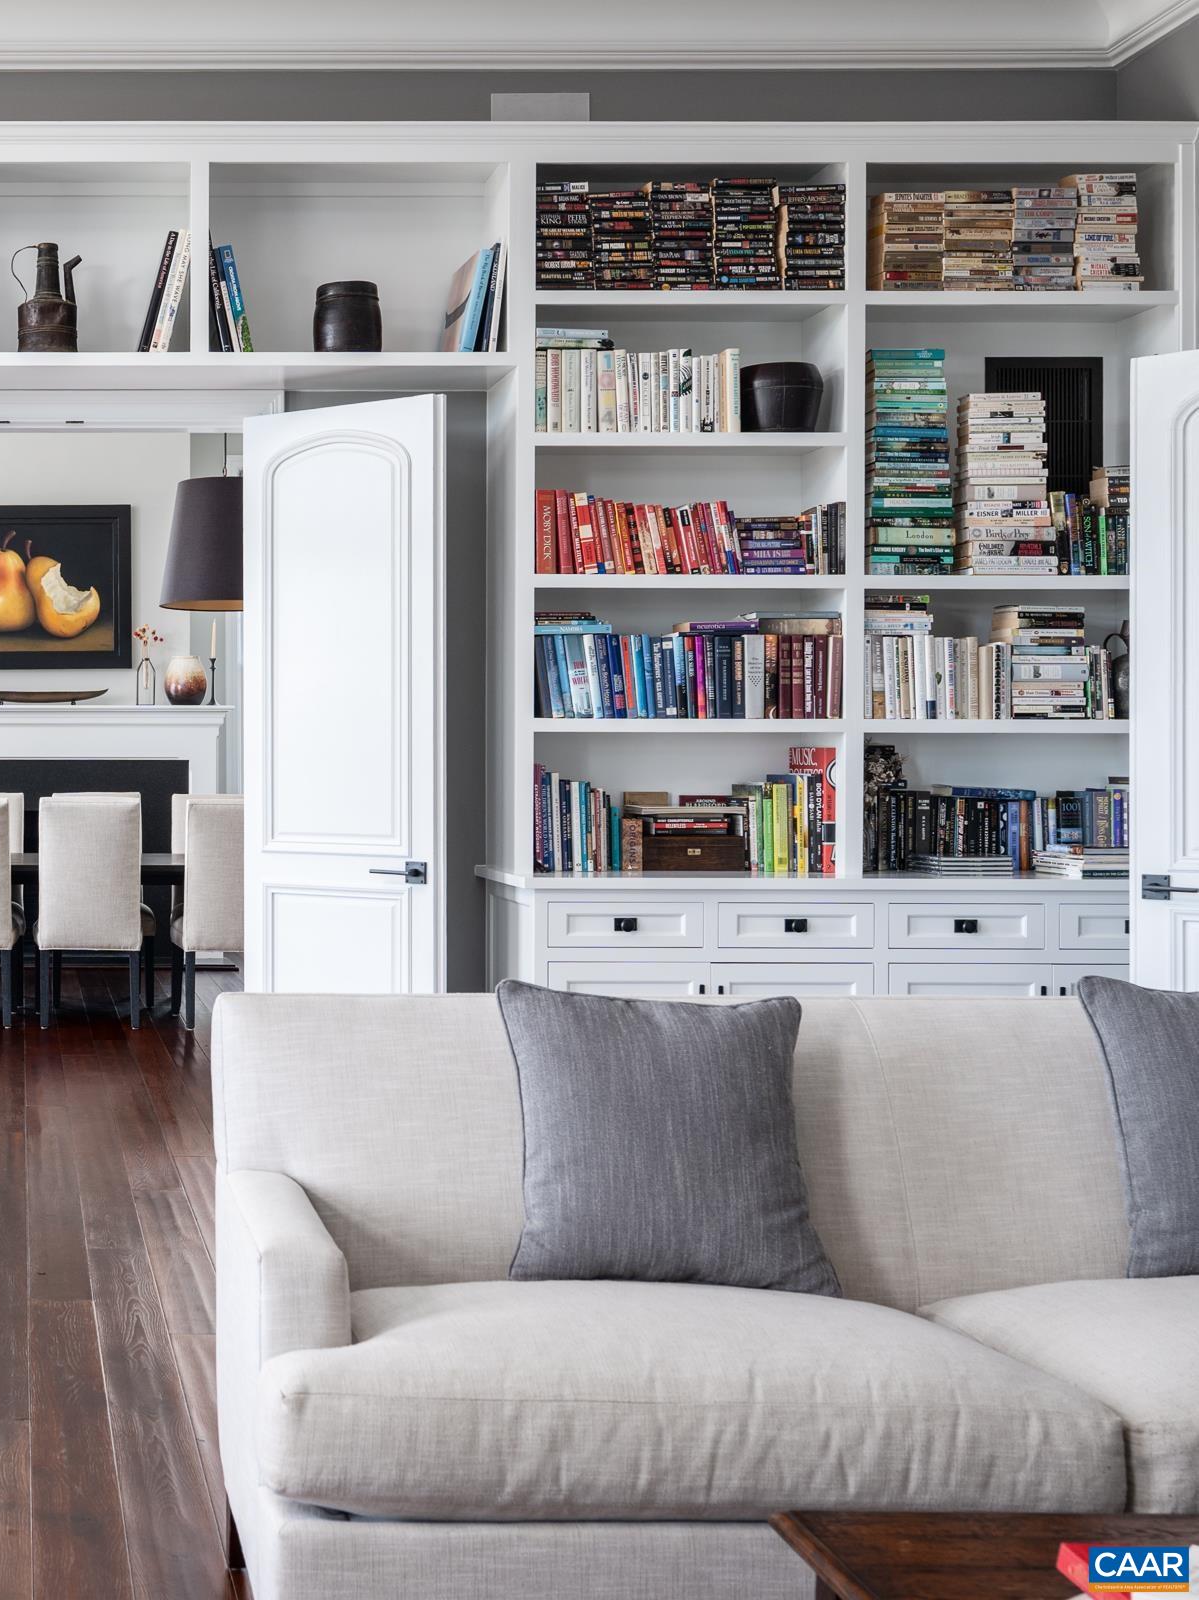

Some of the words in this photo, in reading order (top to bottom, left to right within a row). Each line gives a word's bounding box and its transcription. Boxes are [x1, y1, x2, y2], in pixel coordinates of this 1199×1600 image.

[172, 286, 180, 302] WAVE
[213, 283, 222, 309] California
[543, 505, 551, 533] MOBY
[906, 531, 934, 539] London
[985, 528, 1006, 538] Birds
[1014, 528, 1030, 538] Prey
[543, 536, 551, 560] DICK
[792, 748, 817, 766] MUSIC,
